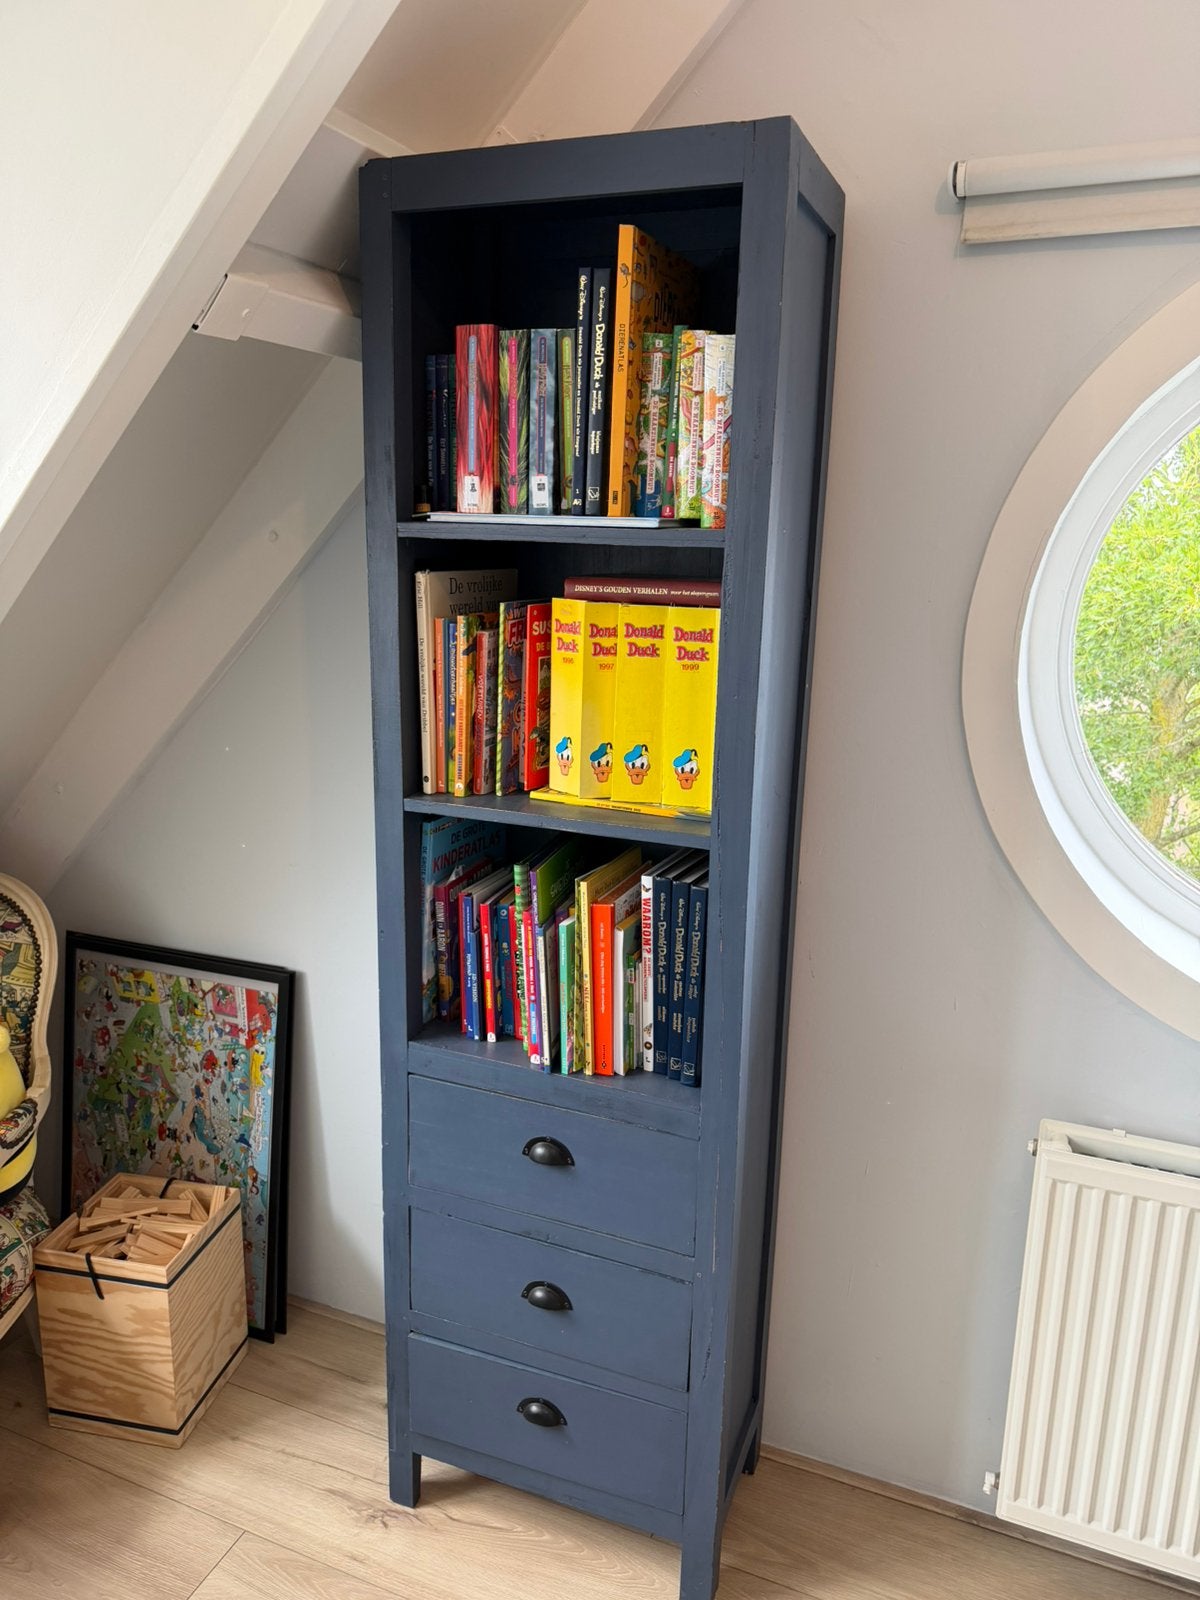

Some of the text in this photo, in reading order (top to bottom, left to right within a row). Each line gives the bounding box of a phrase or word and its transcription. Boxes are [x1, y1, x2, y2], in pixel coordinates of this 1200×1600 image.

[594, 323, 605, 356] Donald
[617, 323, 626, 373] DIERENATLAS
[593, 357, 604, 380] Duck
[653, 400, 659, 410] DE
[694, 401, 700, 411] DE
[718, 407, 724, 417] DE
[650, 412, 658, 458] WAANZINNIGE
[691, 413, 699, 461] WAANZINNIGE
[715, 419, 723, 468] WAANZINNIGE
[449, 575, 504, 597] De vrolijke
[575, 584, 603, 592] DISNEY'S
[603, 585, 632, 594] GOUDEN
[632, 587, 668, 595] VERHALEN
[449, 597, 484, 618] wereld
[554, 618, 582, 636] Donald
[624, 622, 664, 641] Donald
[673, 626, 714, 644] Donald
[419, 638, 425, 646] De
[557, 637, 579, 655] Duck
[627, 642, 660, 658] Duck
[676, 646, 710, 662] Duck
[599, 662, 614, 671] 1997
[451, 829, 462, 845] DE
[432, 832, 501, 873] KINDERATLAS
[436, 901, 446, 922] QUINN
[642, 897, 652, 954] WAAROM?
[658, 922, 667, 947] Donald
[436, 928, 447, 952] AARON
[675, 928, 684, 954] Donald
[692, 931, 701, 957] Donald
[658, 948, 666, 967] Duck
[674, 954, 684, 973] Duck
[691, 958, 700, 977] Duck
